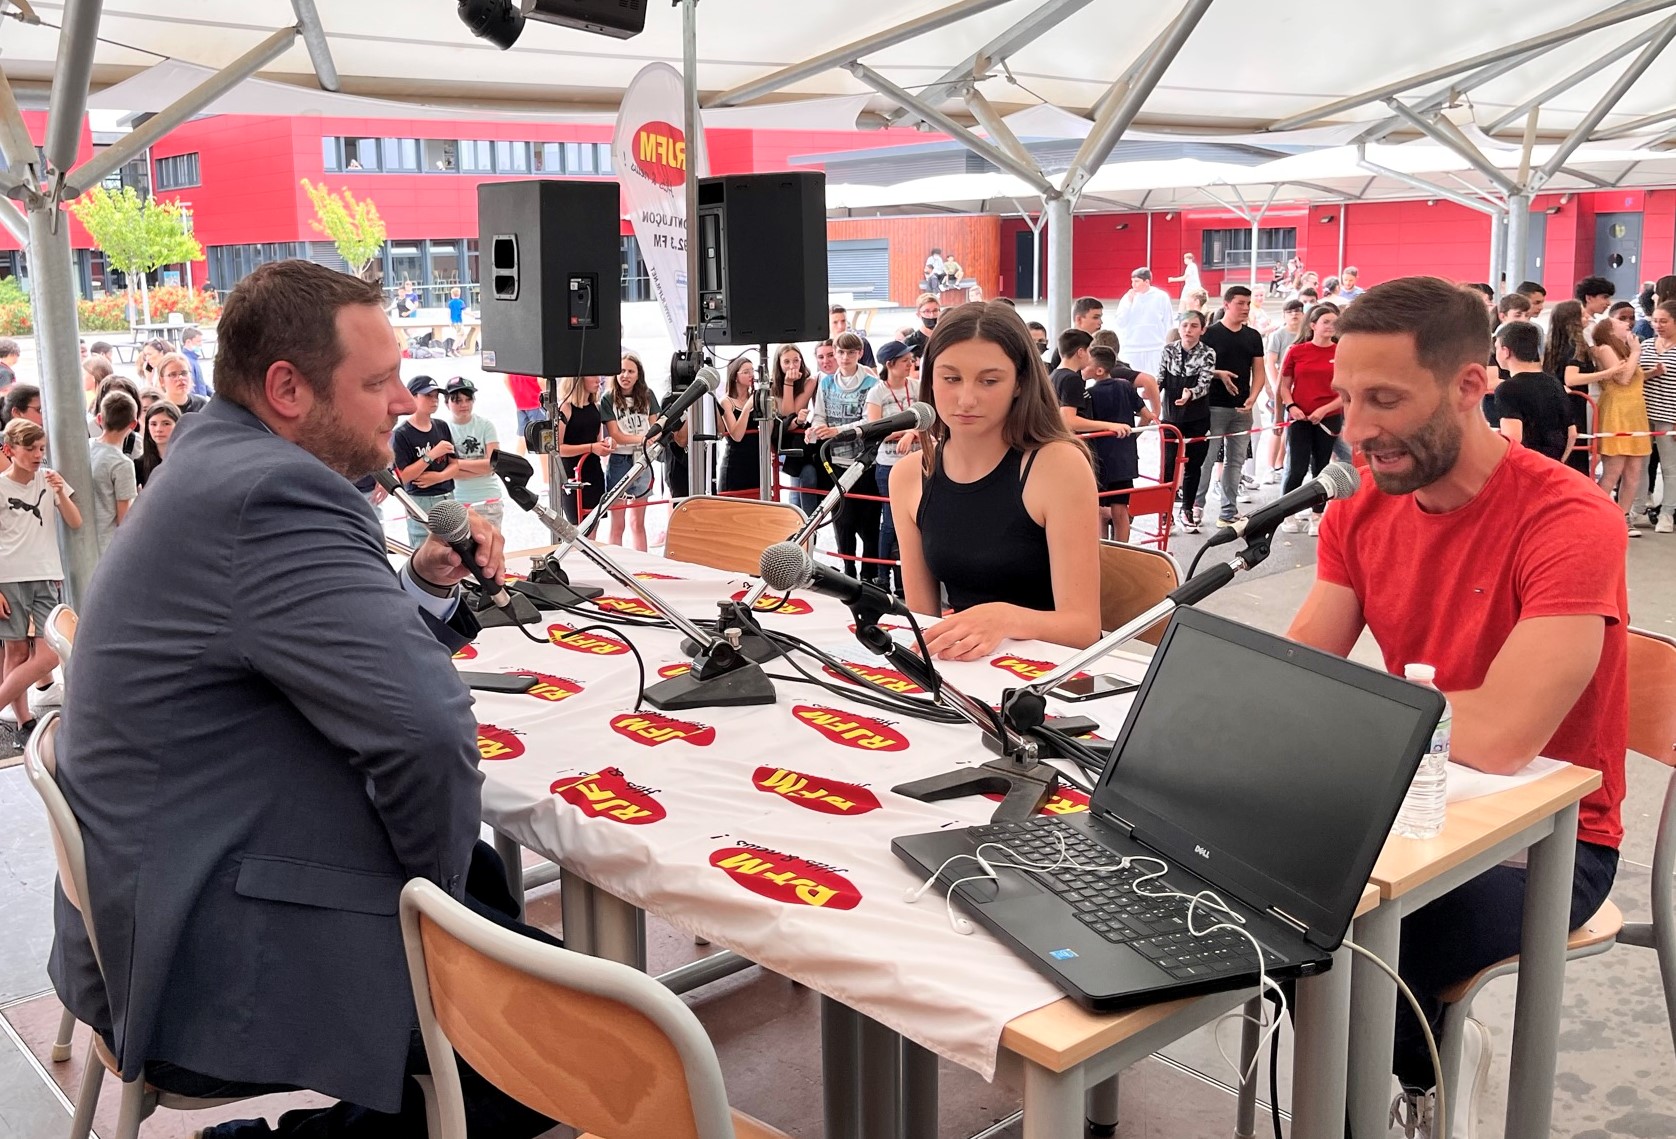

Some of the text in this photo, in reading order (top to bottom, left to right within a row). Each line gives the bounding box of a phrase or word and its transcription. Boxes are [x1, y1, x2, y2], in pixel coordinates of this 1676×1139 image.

[798, 711, 897, 750] RJFM
[555, 773, 653, 821] RJF
[1194, 844, 1210, 859] DELL
